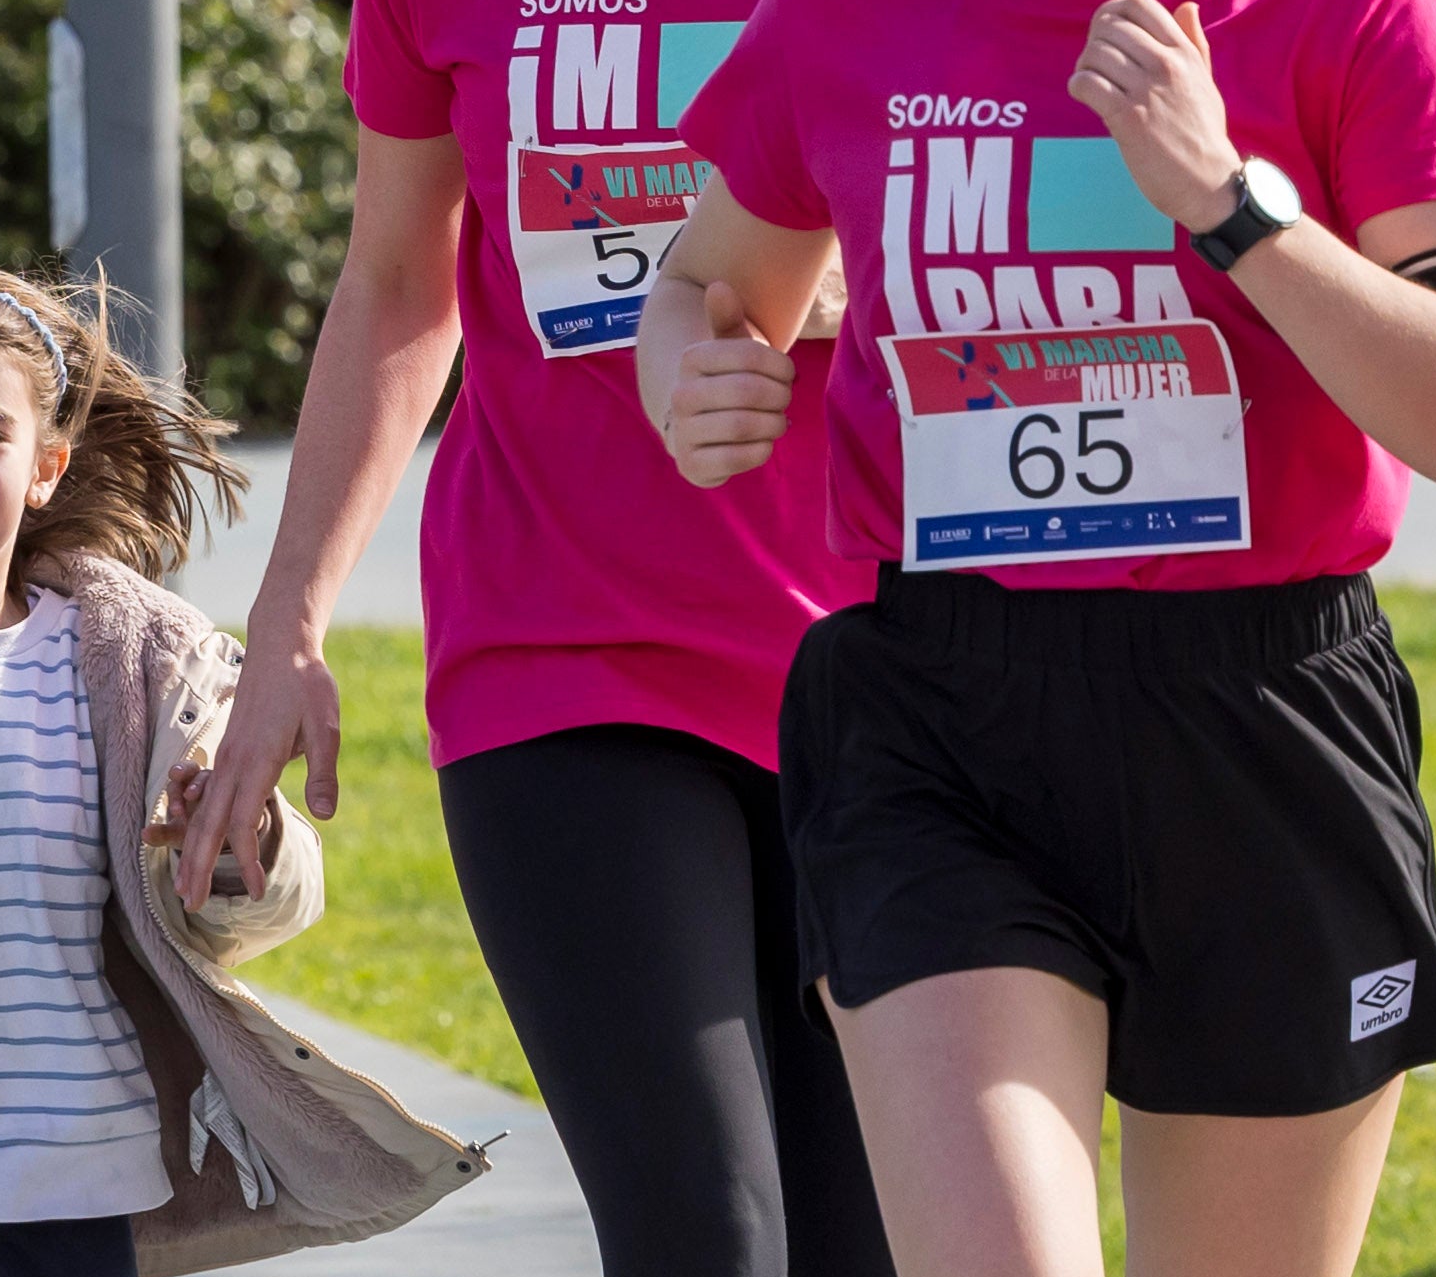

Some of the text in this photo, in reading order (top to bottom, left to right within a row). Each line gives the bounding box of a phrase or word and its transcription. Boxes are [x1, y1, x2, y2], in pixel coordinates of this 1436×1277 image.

[888, 94, 1028, 129] SOMOS
[602, 166, 639, 199] VI
[646, 196, 681, 208] DE LA
[995, 334, 1187, 371] VI MARCHA
[1044, 362, 1193, 403] DE LA MUJER
[1008, 408, 1134, 500] 65
[1360, 1007, 1403, 1032] umbro
